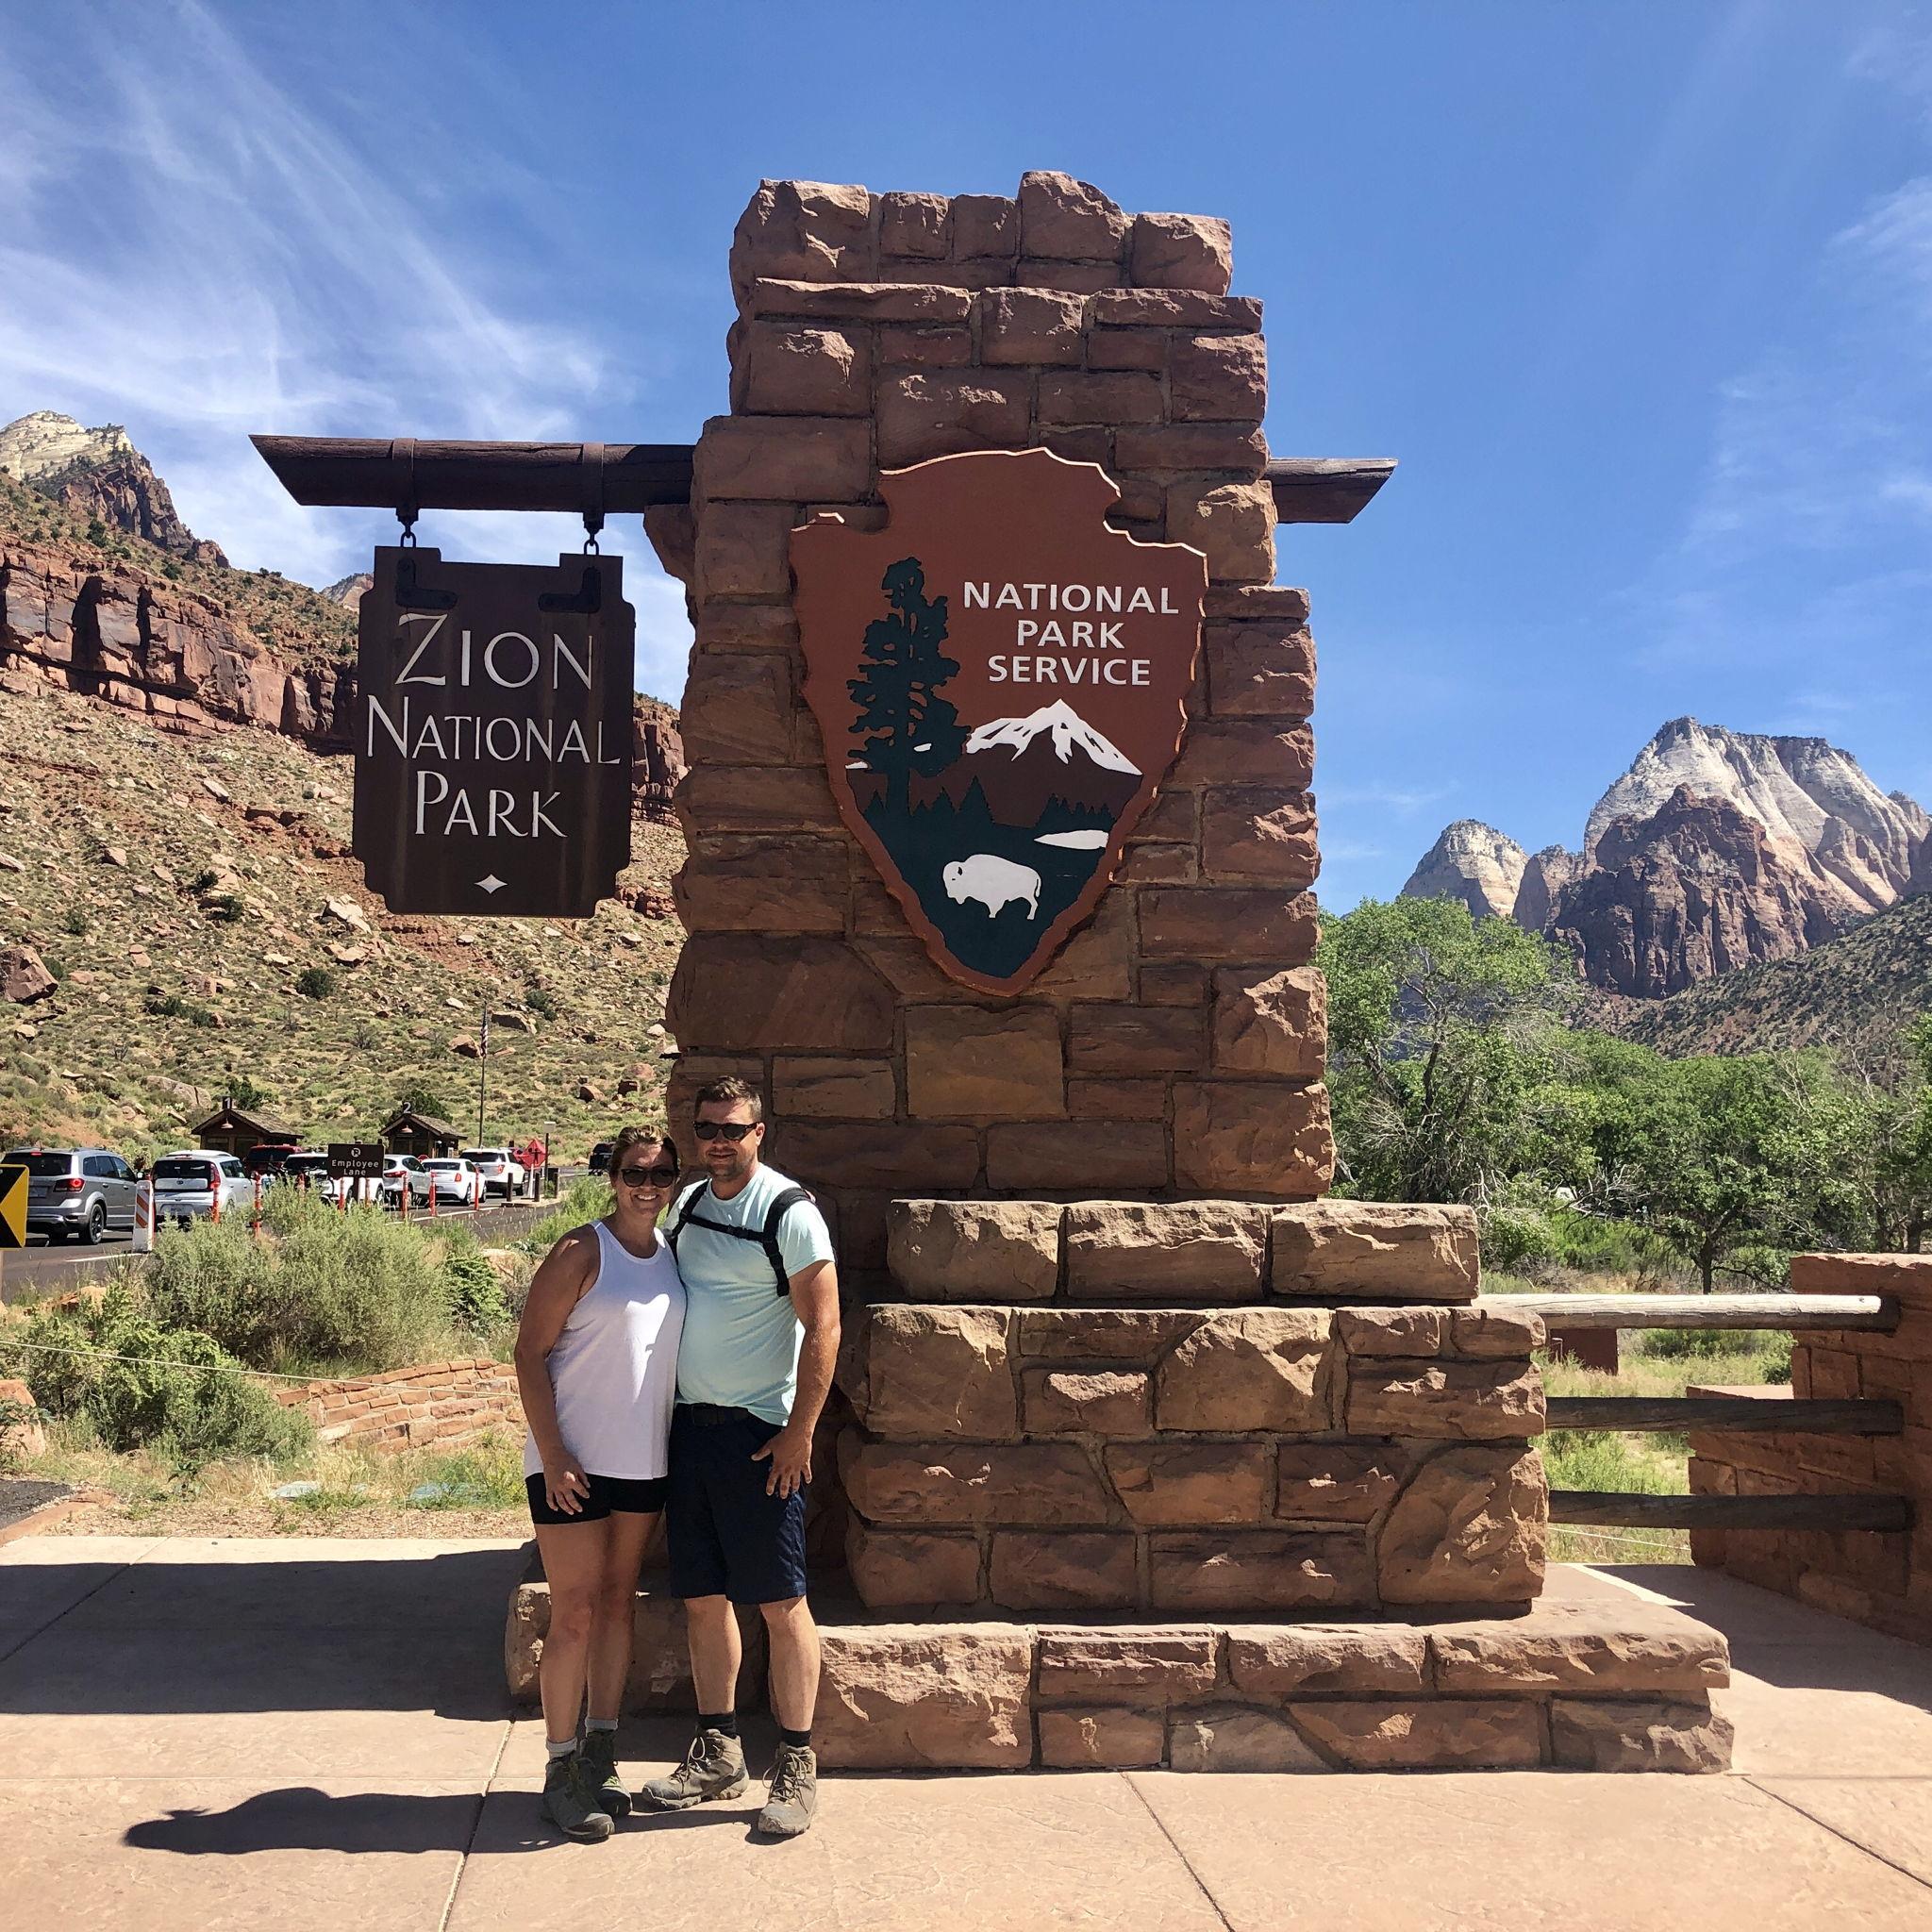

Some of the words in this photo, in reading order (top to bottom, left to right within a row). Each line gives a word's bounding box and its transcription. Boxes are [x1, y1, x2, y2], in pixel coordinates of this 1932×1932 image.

[963, 581, 1179, 614] NATIONAL
[1017, 619, 1125, 649] PARK
[394, 613, 592, 690] ZION
[988, 655, 1151, 686] SERVICE
[367, 694, 621, 764] NATIONAL
[415, 770, 568, 837] PARK
[225, 1097, 231, 1109] 1
[403, 1102, 411, 1113] 2
[331, 1159, 379, 1169] Employee
